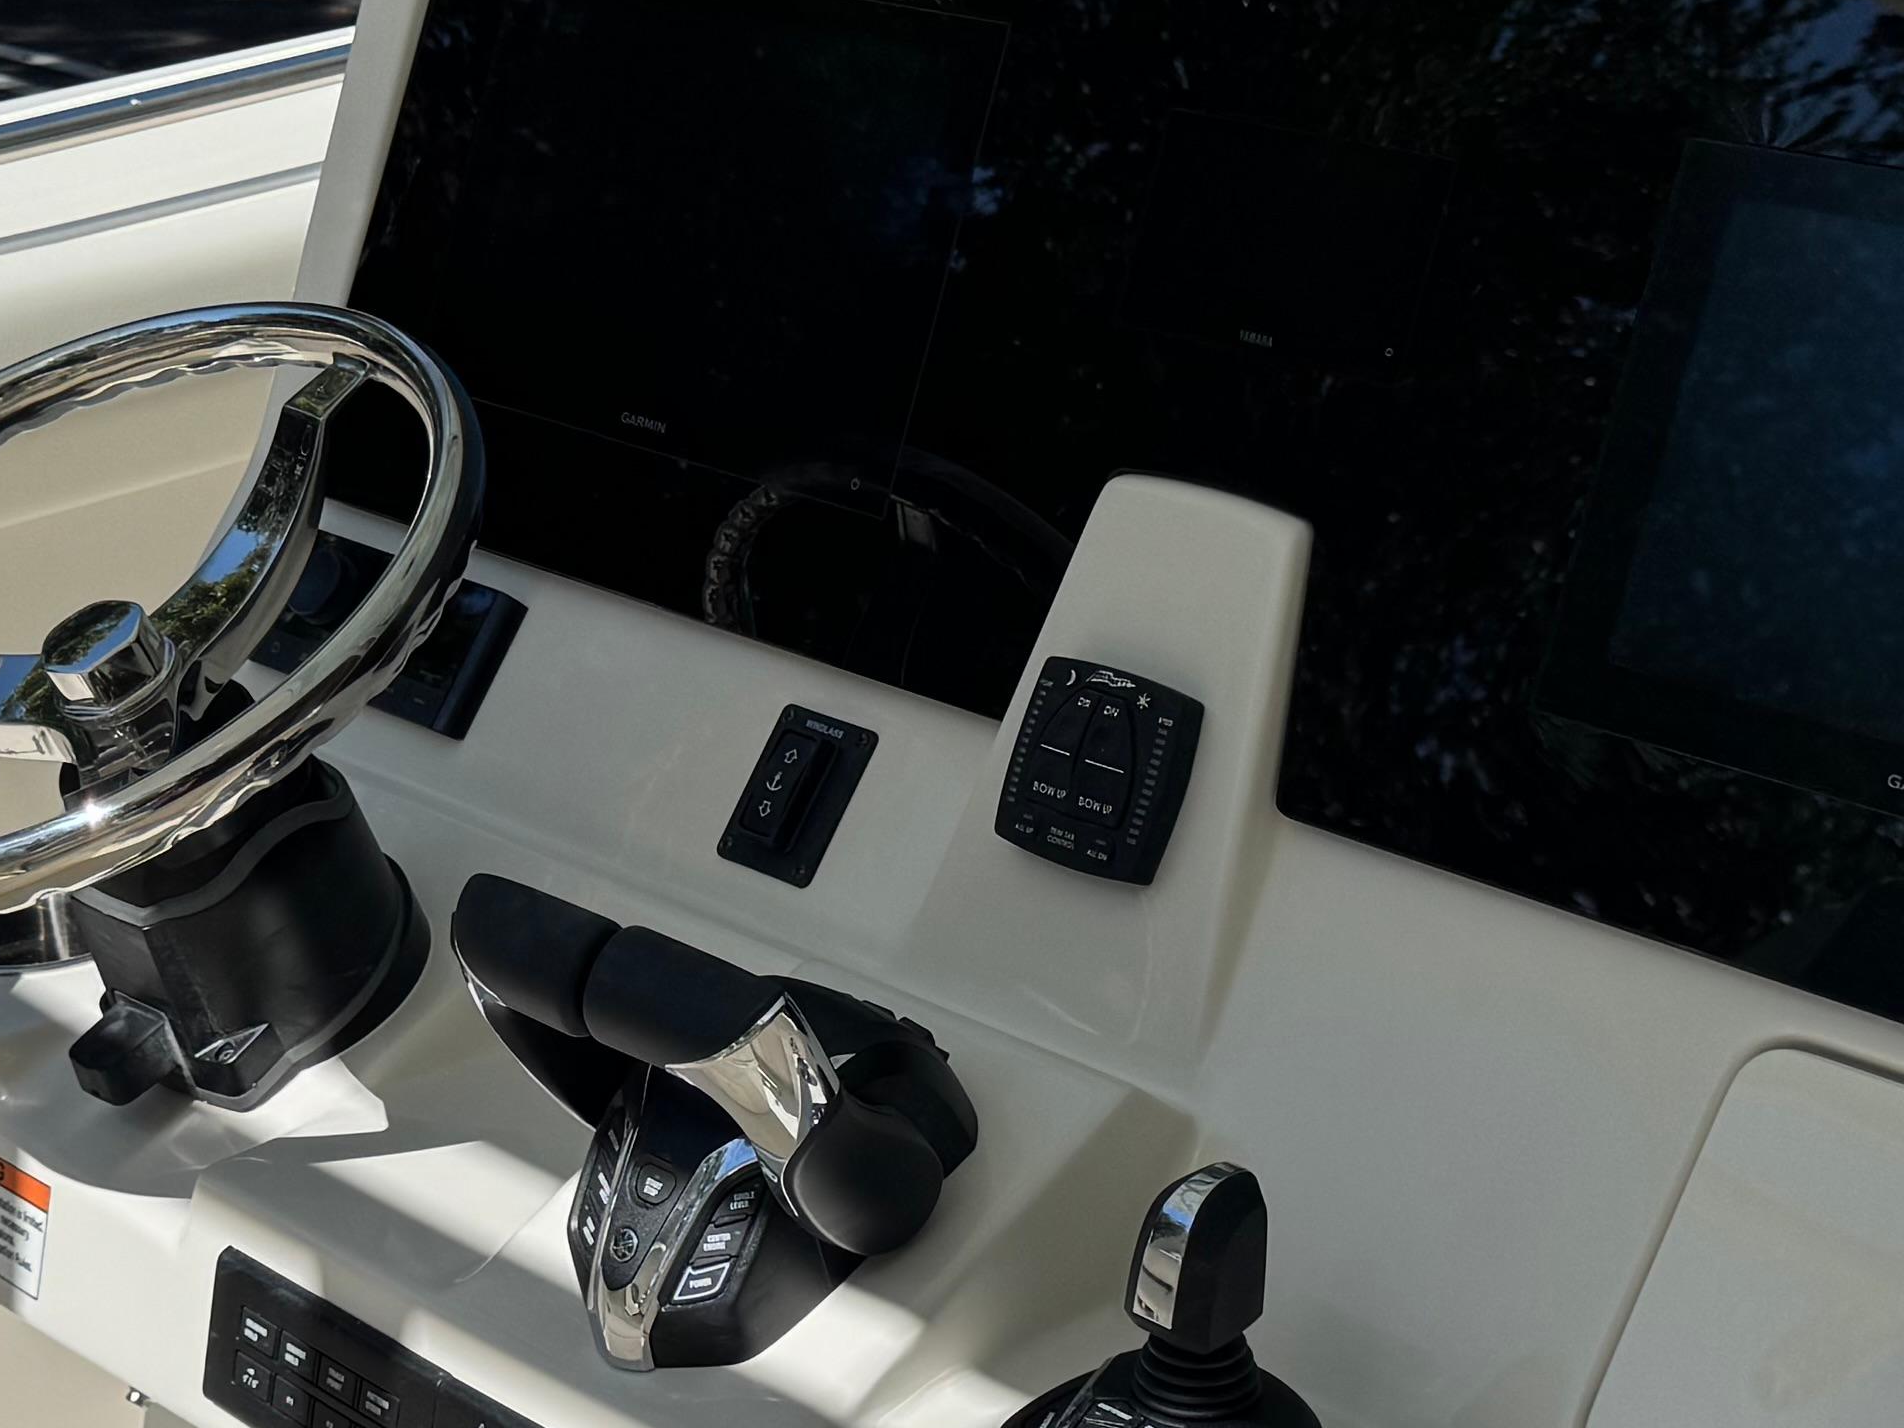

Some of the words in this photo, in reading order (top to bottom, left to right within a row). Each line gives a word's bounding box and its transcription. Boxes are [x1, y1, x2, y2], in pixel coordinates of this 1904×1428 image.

[620, 411, 666, 434] GARMIN
[1032, 780, 1055, 797] BOW
[1078, 795, 1101, 812] BOW
